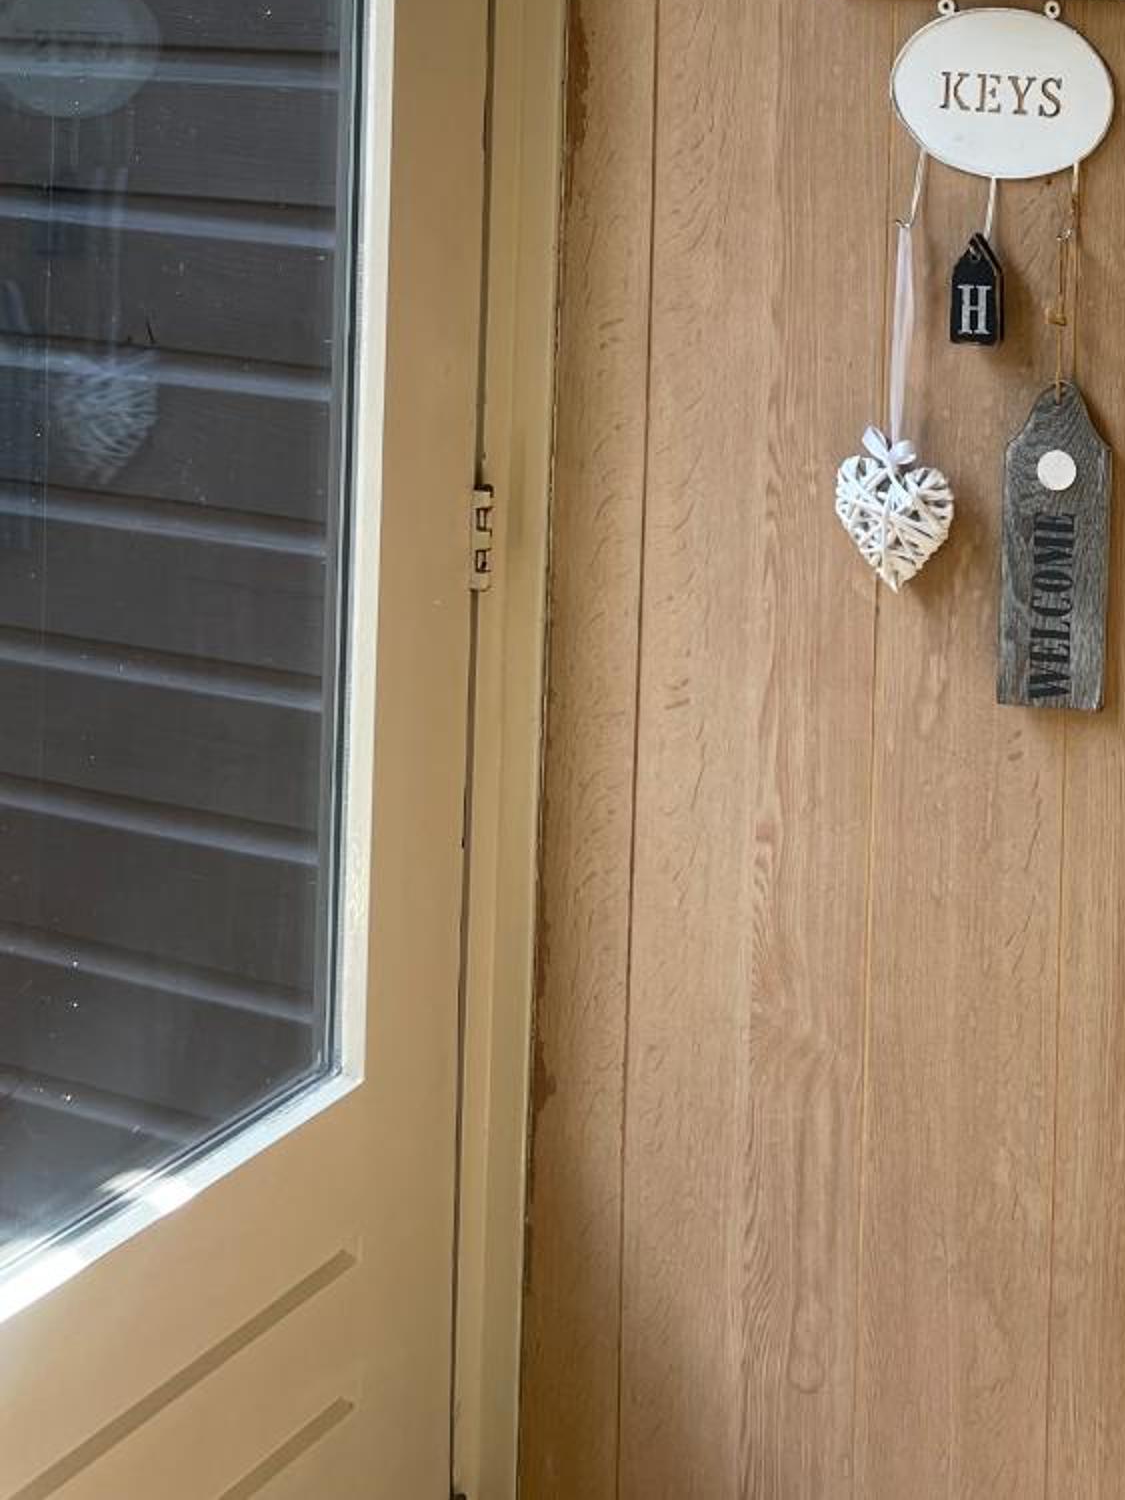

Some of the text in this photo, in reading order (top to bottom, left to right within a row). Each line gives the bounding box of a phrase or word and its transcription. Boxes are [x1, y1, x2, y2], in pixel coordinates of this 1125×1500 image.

[940, 71, 1063, 118] KEYS
[957, 284, 992, 336] H
[1028, 512, 1076, 699] WELCOME
